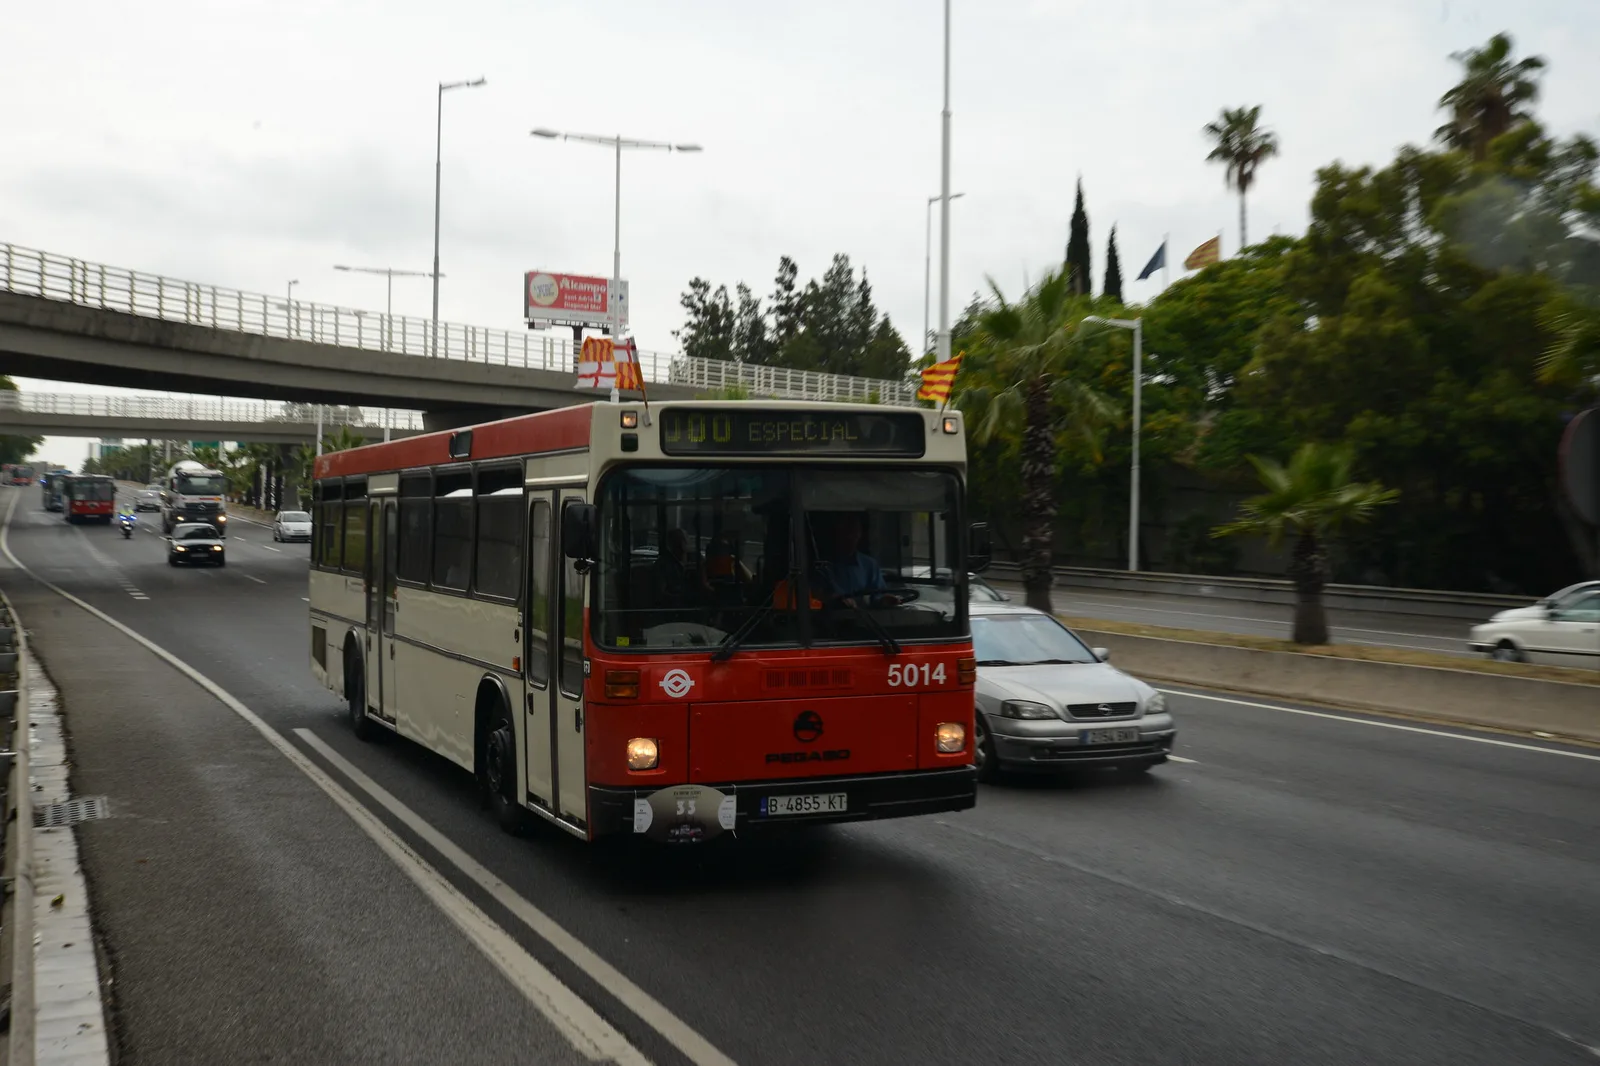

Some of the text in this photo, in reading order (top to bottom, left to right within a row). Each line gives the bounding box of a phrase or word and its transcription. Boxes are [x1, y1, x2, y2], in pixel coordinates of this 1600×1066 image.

[560, 277, 606, 293] Alcampo
[564, 300, 589, 310] Diagonal
[749, 420, 858, 442] ESPECIAL
[887, 662, 947, 687] 5014
[765, 749, 851, 764] PEGASO
